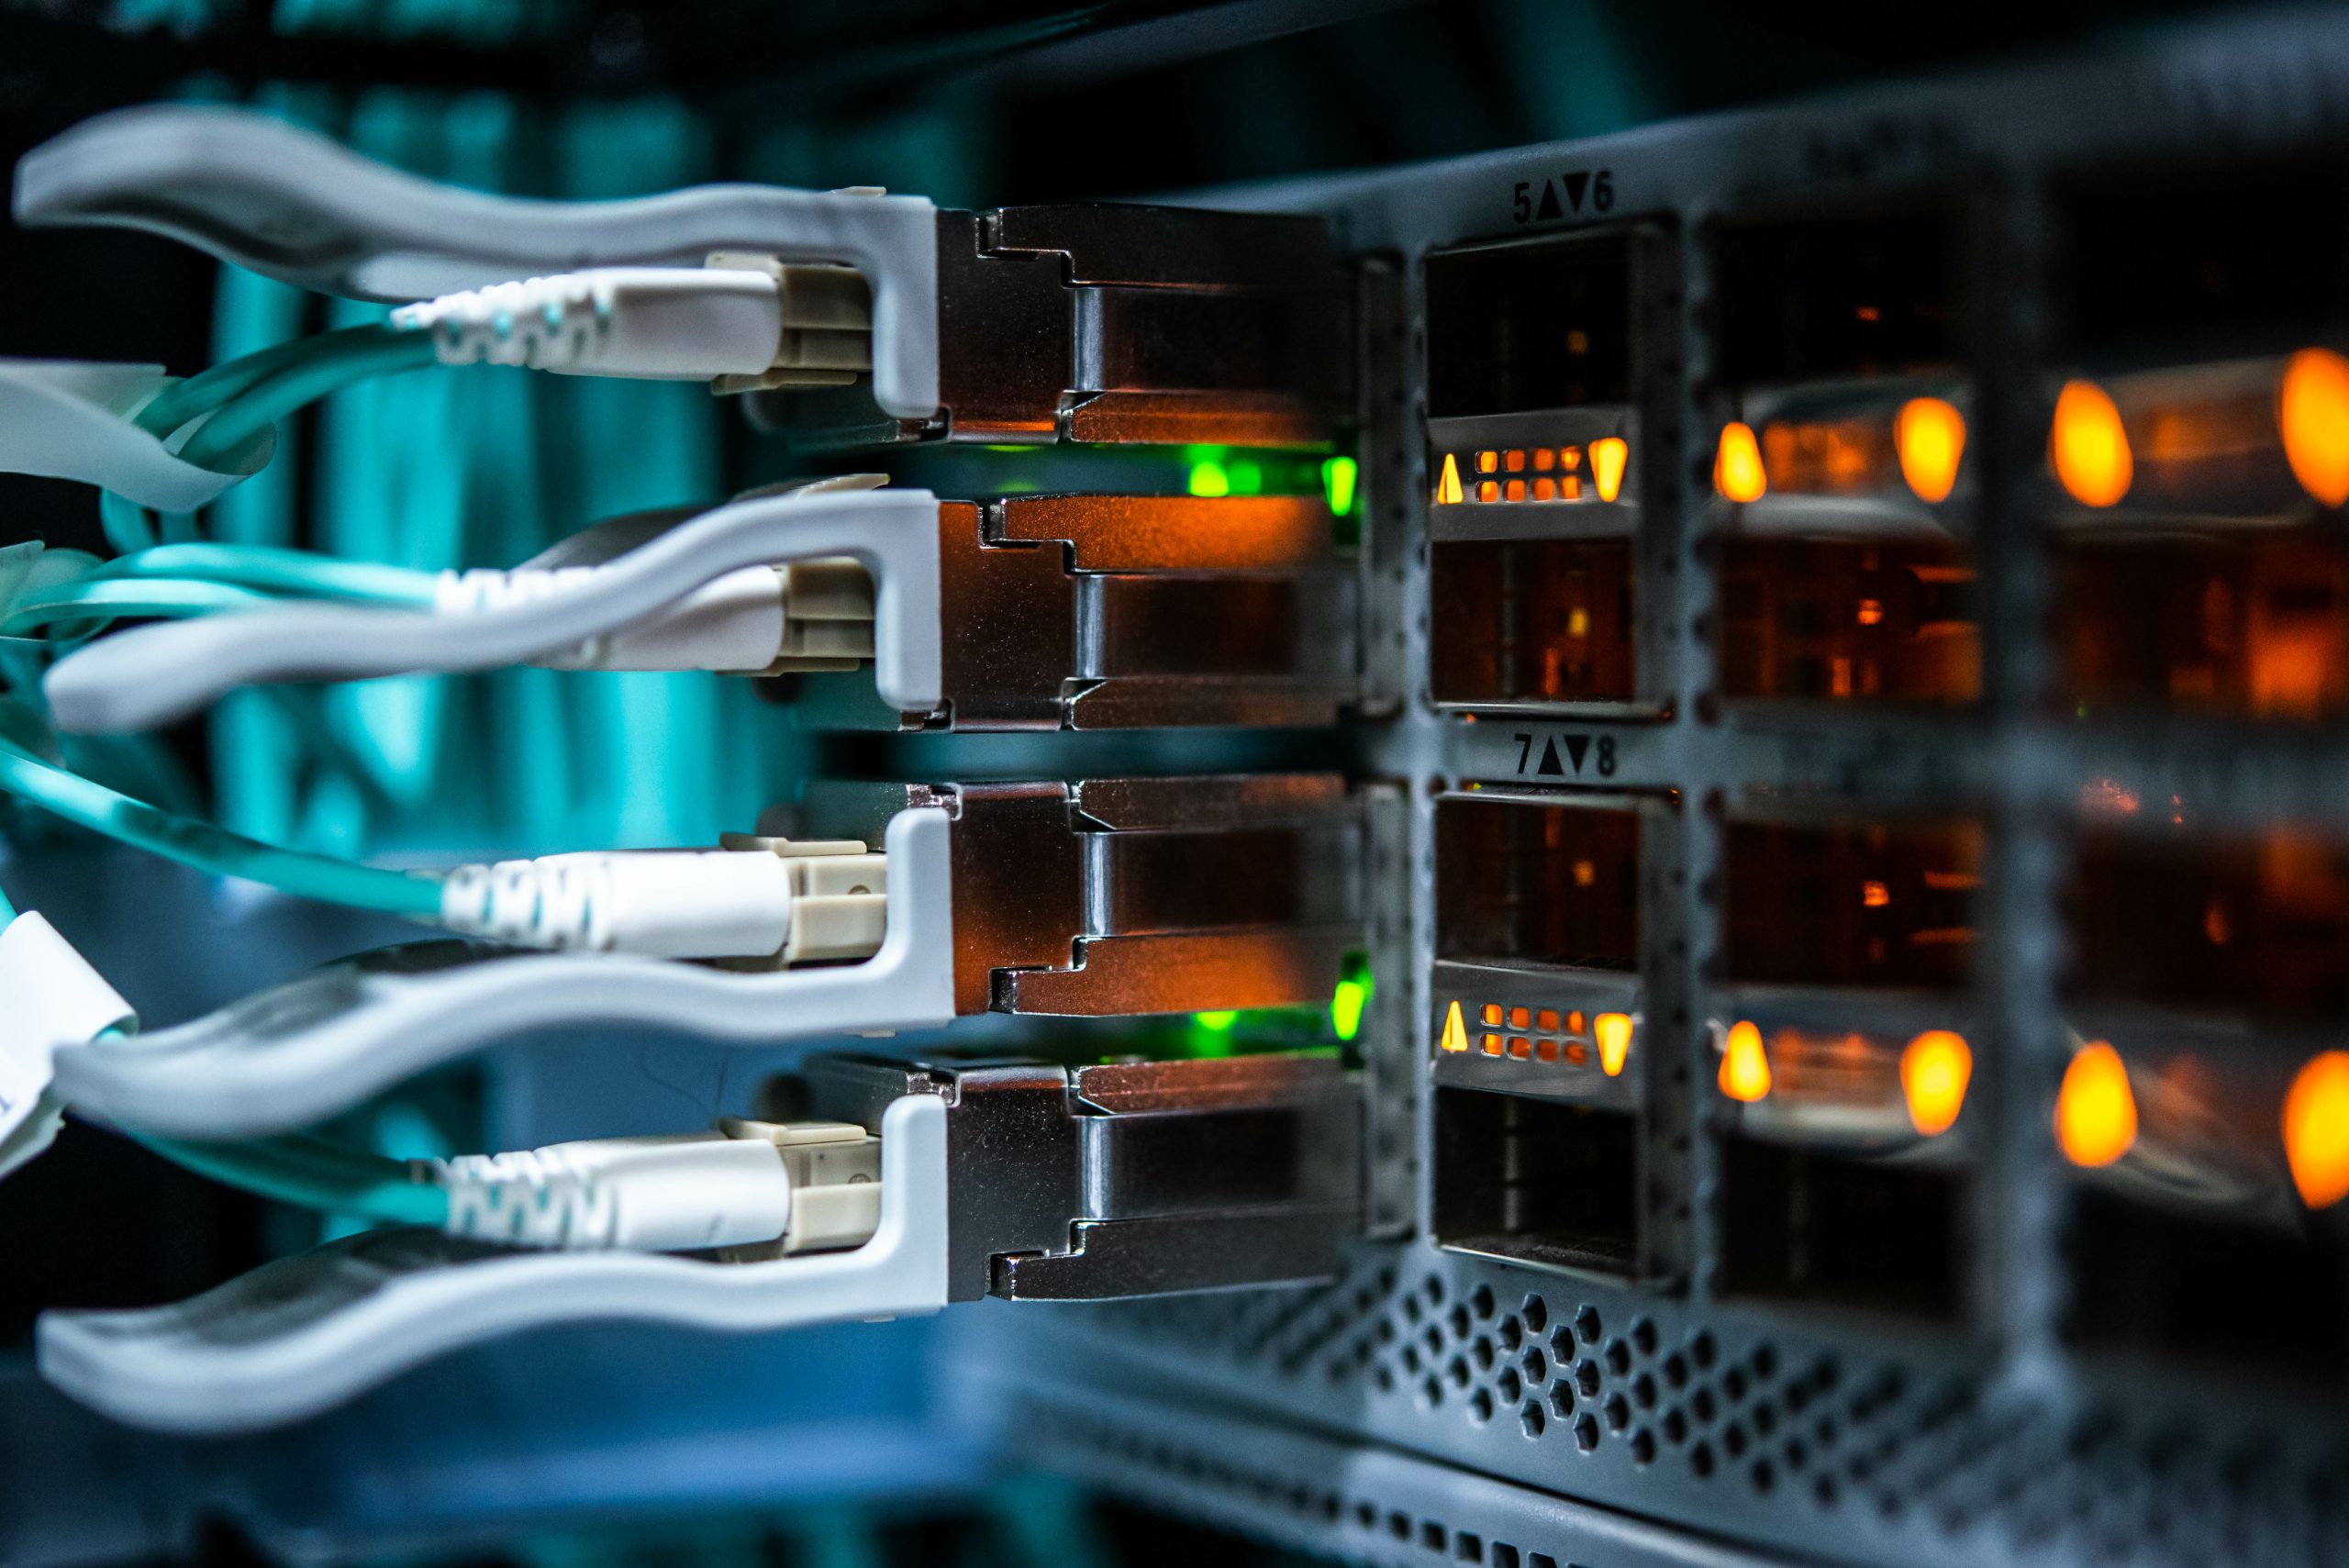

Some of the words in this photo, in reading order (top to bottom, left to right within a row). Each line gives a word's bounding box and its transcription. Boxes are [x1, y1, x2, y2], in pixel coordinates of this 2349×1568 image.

[1513, 181, 1531, 224] 5
[1594, 170, 1614, 213] 6
[1514, 733, 1532, 774] 7
[1597, 734, 1617, 777] 8
